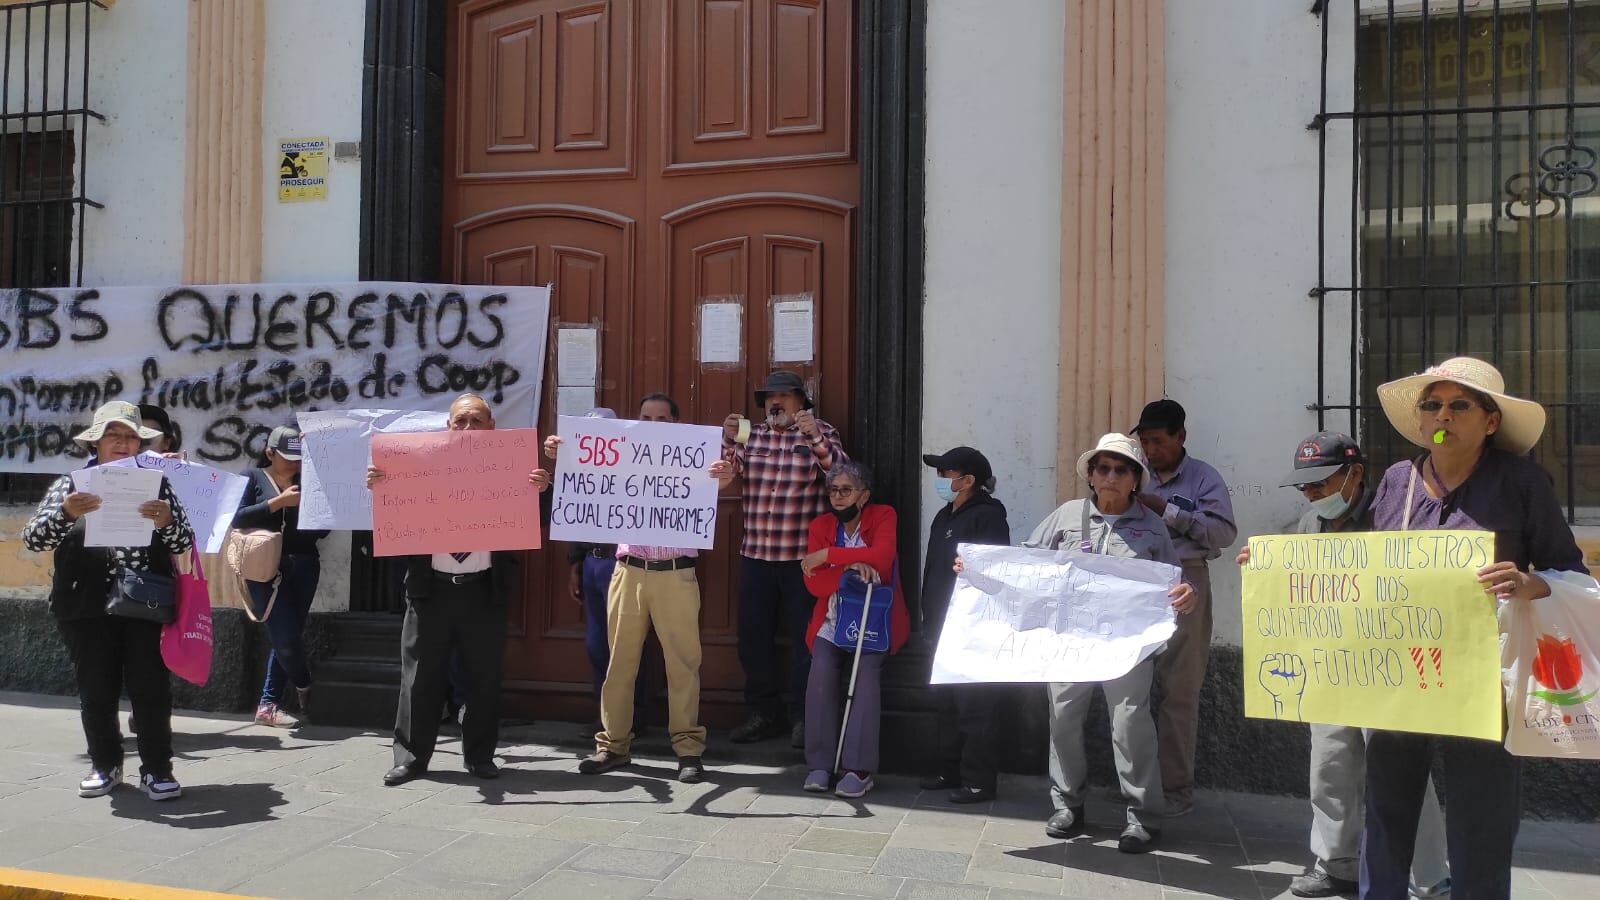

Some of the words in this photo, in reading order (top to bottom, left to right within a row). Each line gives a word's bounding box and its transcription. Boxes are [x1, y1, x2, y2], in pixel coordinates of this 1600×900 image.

[281, 141, 324, 149] CONECTADA
[280, 178, 324, 187] PROSEGUR
[157, 288, 508, 352] QUEREMOS
[0, 373, 124, 424] nforme
[358, 353, 407, 399] de
[417, 353, 521, 403] Coop
[575, 433, 626, 467] "SBS"
[631, 442, 653, 466] YA
[661, 441, 706, 469] PASÓ
[562, 472, 596, 495] MAS
[600, 474, 617, 495] DE
[625, 474, 639, 497] 6
[642, 475, 691, 499] MESES
[552, 497, 603, 528] ¿CUAL
[607, 504, 624, 529] ES
[627, 504, 645, 530] SU
[649, 507, 715, 539] INFORME?
[1282, 537, 1369, 569] QUITARON
[1384, 534, 1488, 569] NUESTROS
[1290, 572, 1360, 604] AHORROS
[1376, 575, 1409, 602] NOS
[1257, 605, 1343, 640] QUITARON
[1355, 605, 1442, 641] NUESTRO
